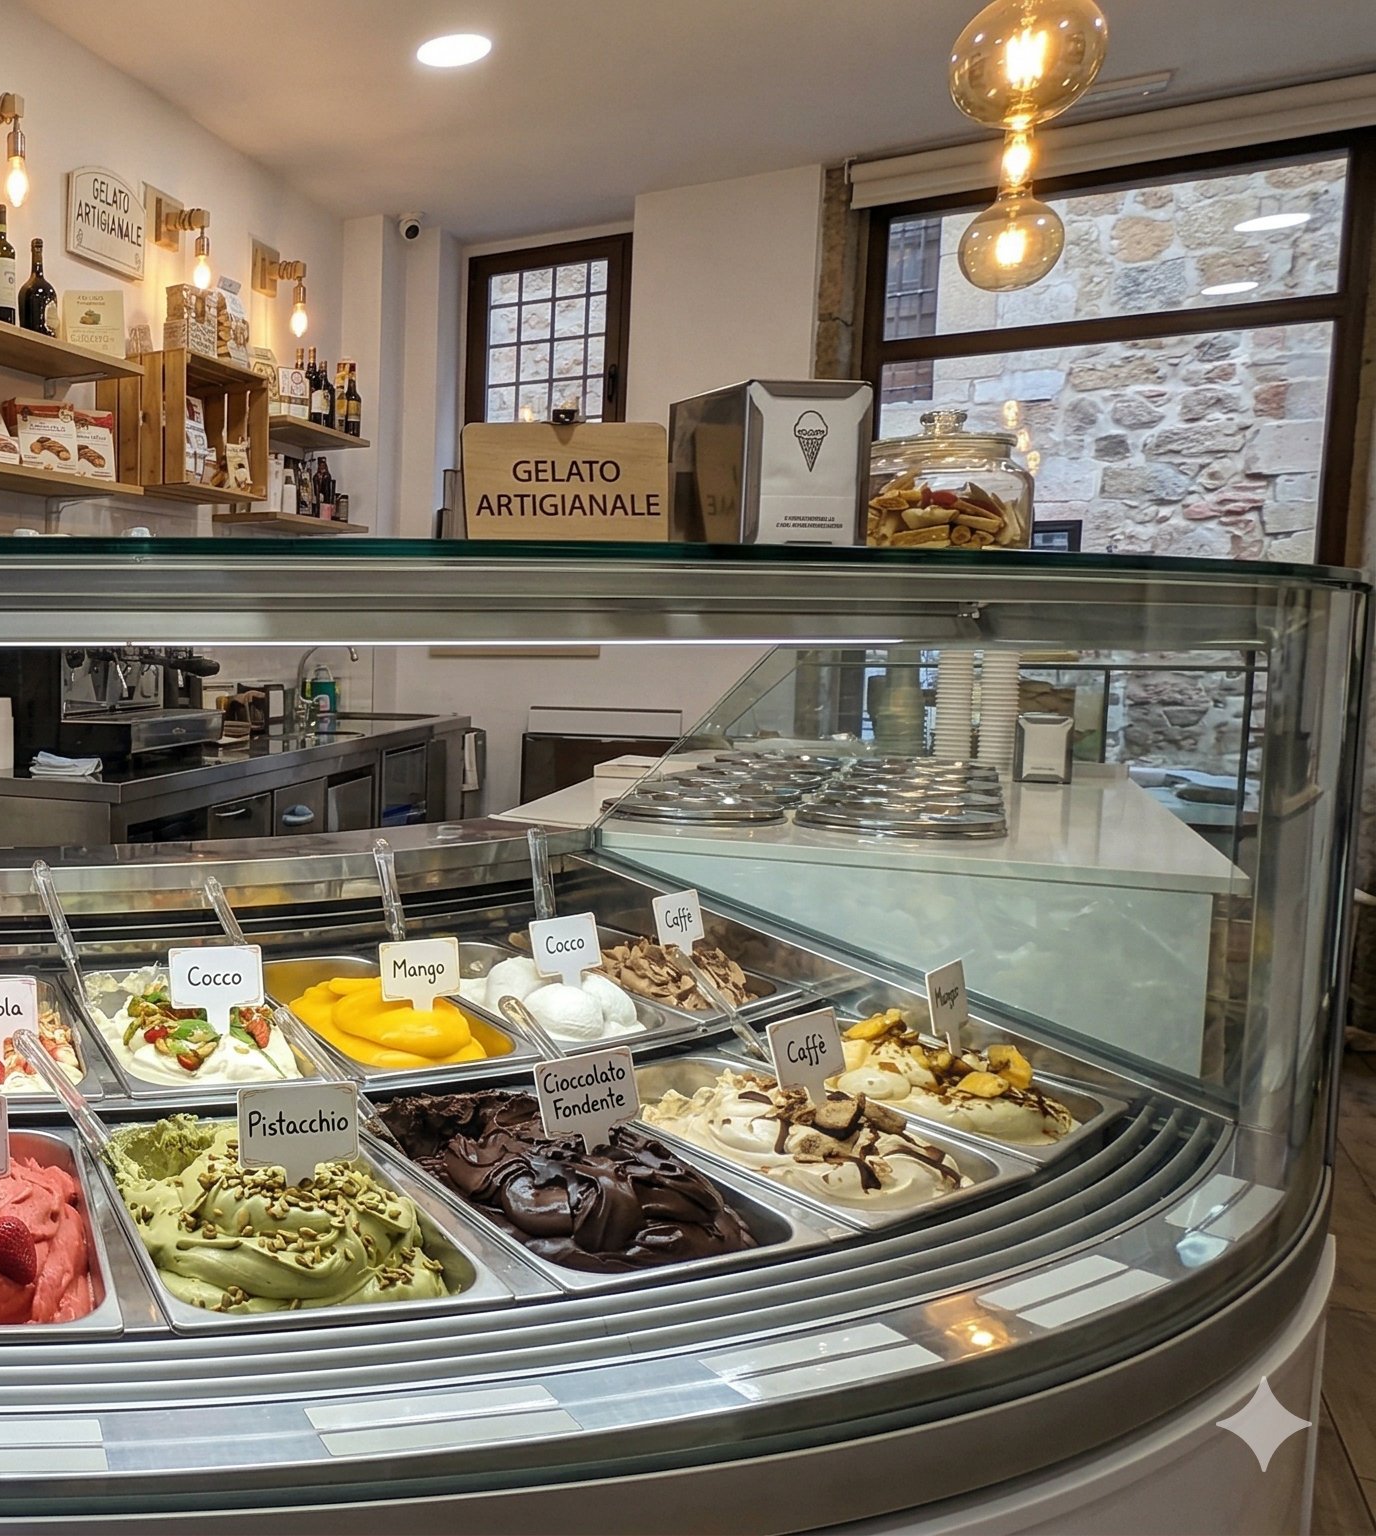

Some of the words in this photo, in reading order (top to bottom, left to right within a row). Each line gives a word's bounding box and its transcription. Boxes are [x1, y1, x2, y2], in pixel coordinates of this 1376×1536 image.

[92, 177, 130, 214] GELATO
[76, 199, 142, 248] ARTIGIANALE
[511, 459, 622, 483] GELATO
[475, 493, 661, 517] ARTIGIANALE
[545, 935, 585, 955] Cocco
[187, 966, 242, 987] Cocco
[393, 959, 445, 984] Mango
[787, 1034, 827, 1067] Caffè
[543, 1059, 626, 1095] Cioccolato
[553, 1086, 626, 1120] Fondente
[247, 1109, 349, 1138] Pistacchio
